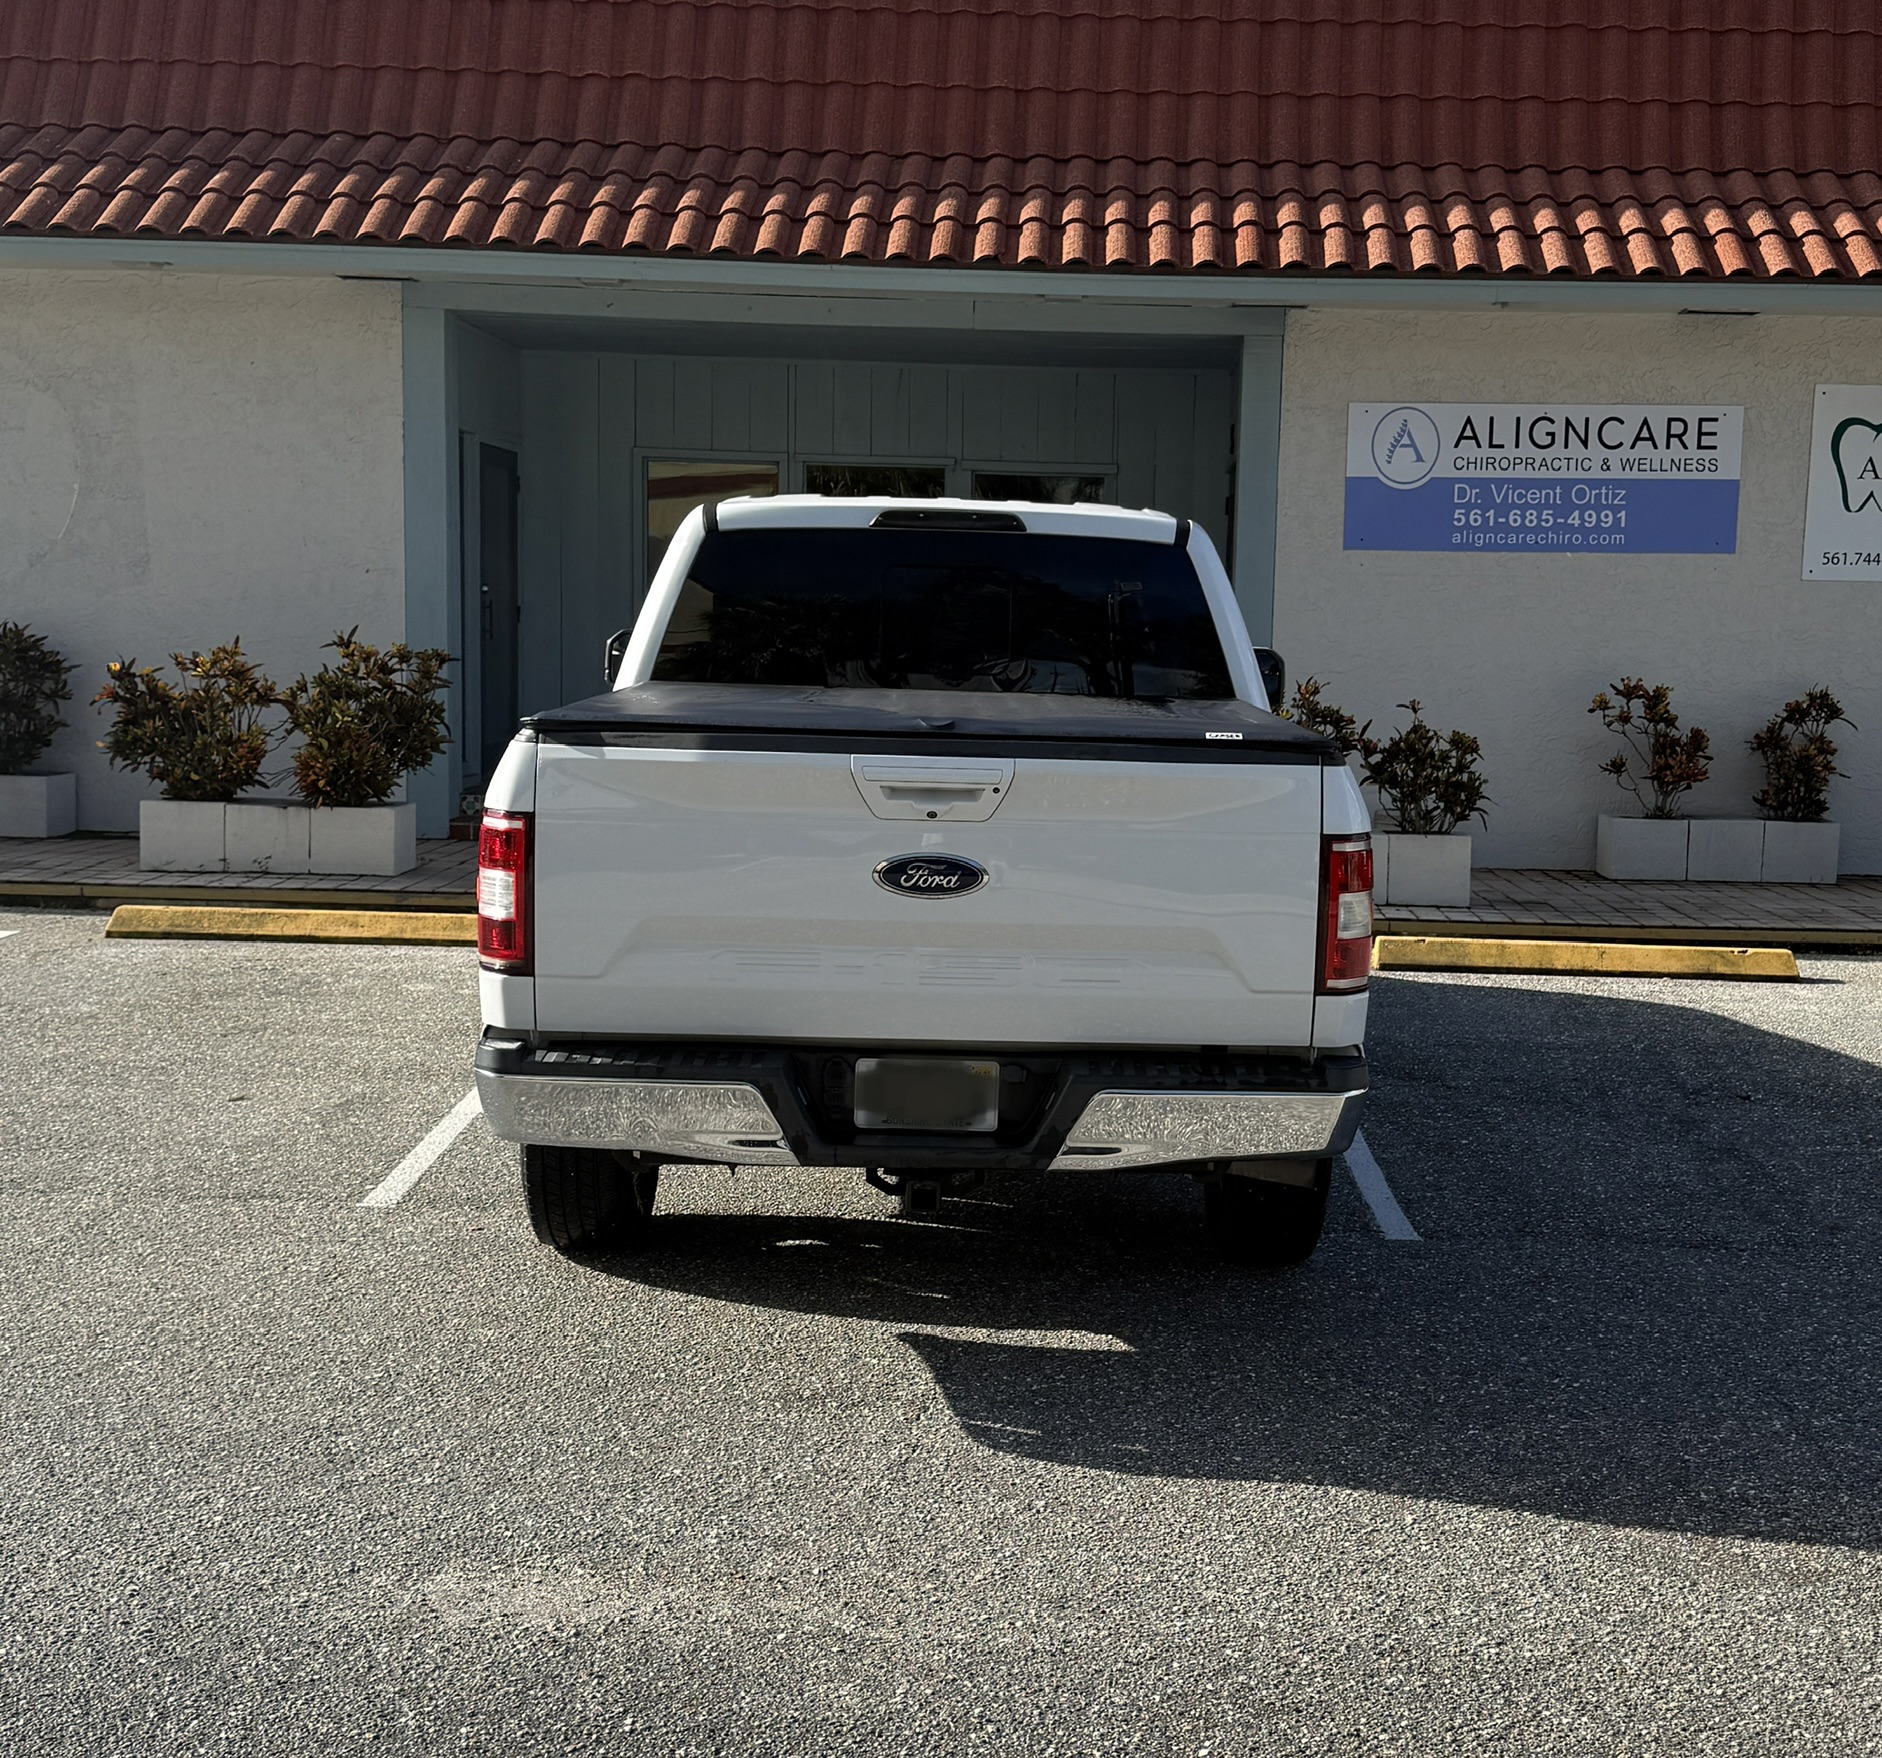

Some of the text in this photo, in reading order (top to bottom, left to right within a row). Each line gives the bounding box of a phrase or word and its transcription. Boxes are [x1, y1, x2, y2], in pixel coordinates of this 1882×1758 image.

[1453, 415, 1719, 450] ALIGNCARE
[1453, 456, 1719, 473] CHIROPRACTIC & WELLNESS
[1453, 483, 1627, 505] Dr. Vicent Ortiz
[1453, 509, 1626, 528] 561-685-4991
[1452, 530, 1625, 547] aligncarechiro.com
[900, 862, 960, 888] Ford
